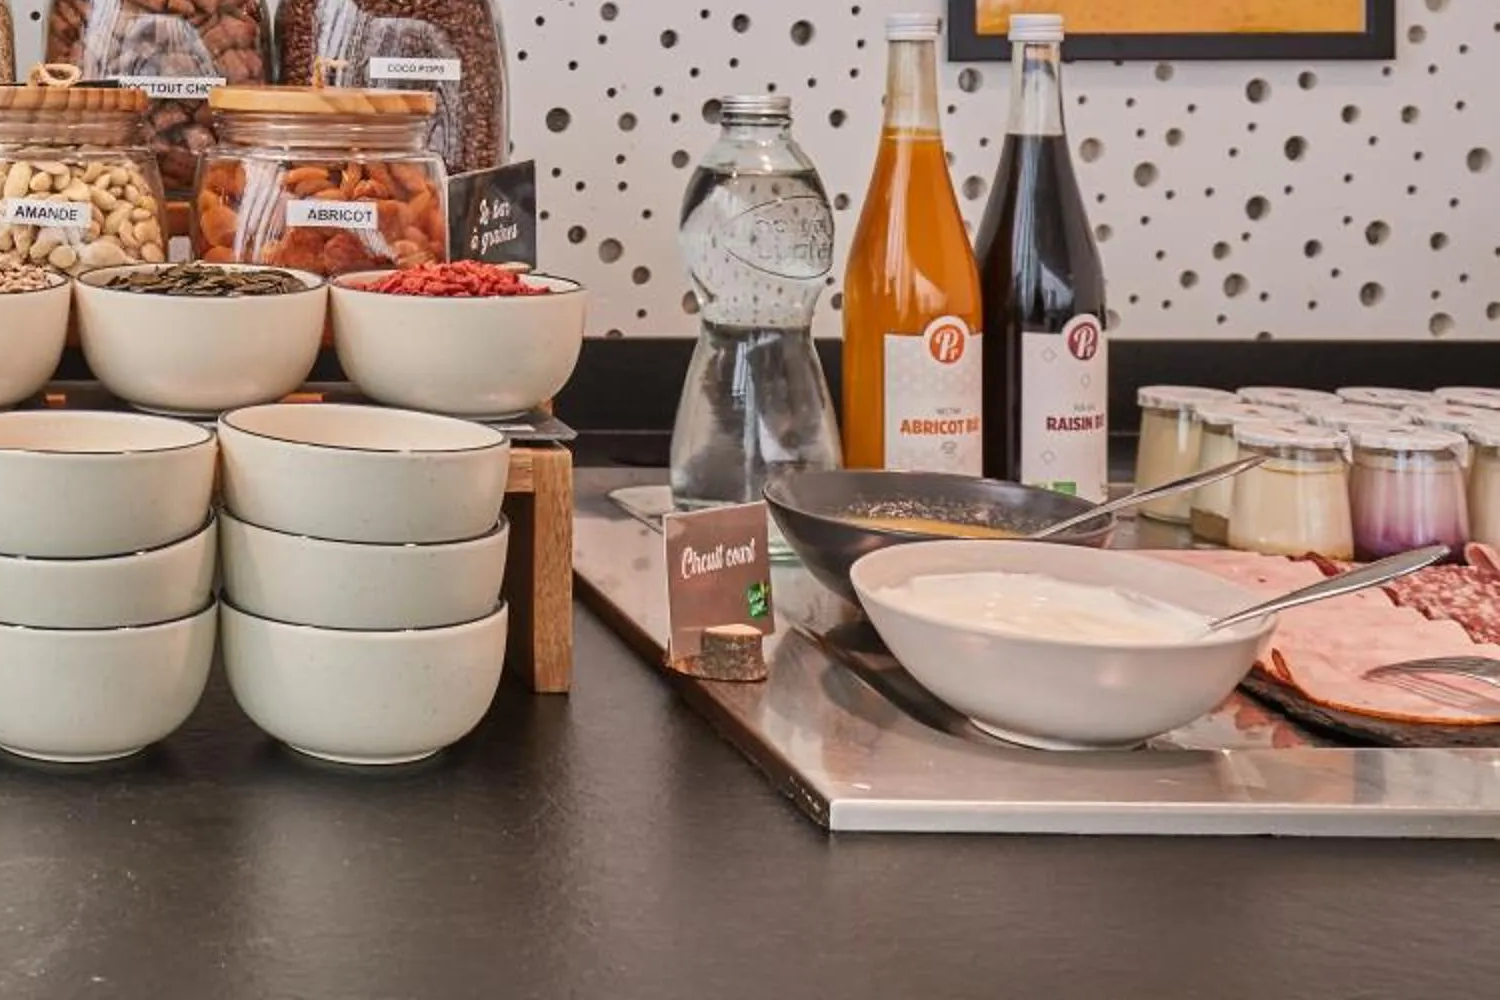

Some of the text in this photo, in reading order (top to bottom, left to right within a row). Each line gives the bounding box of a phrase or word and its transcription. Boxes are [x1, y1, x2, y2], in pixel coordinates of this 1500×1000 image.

[387, 63, 417, 73] COCO
[14, 205, 79, 221] AMANDE
[307, 208, 373, 223] ABRICOT
[900, 419, 964, 435] ABRICOT
[1046, 415, 1092, 431] RAISIN
[681, 537, 756, 579] Circuit court
